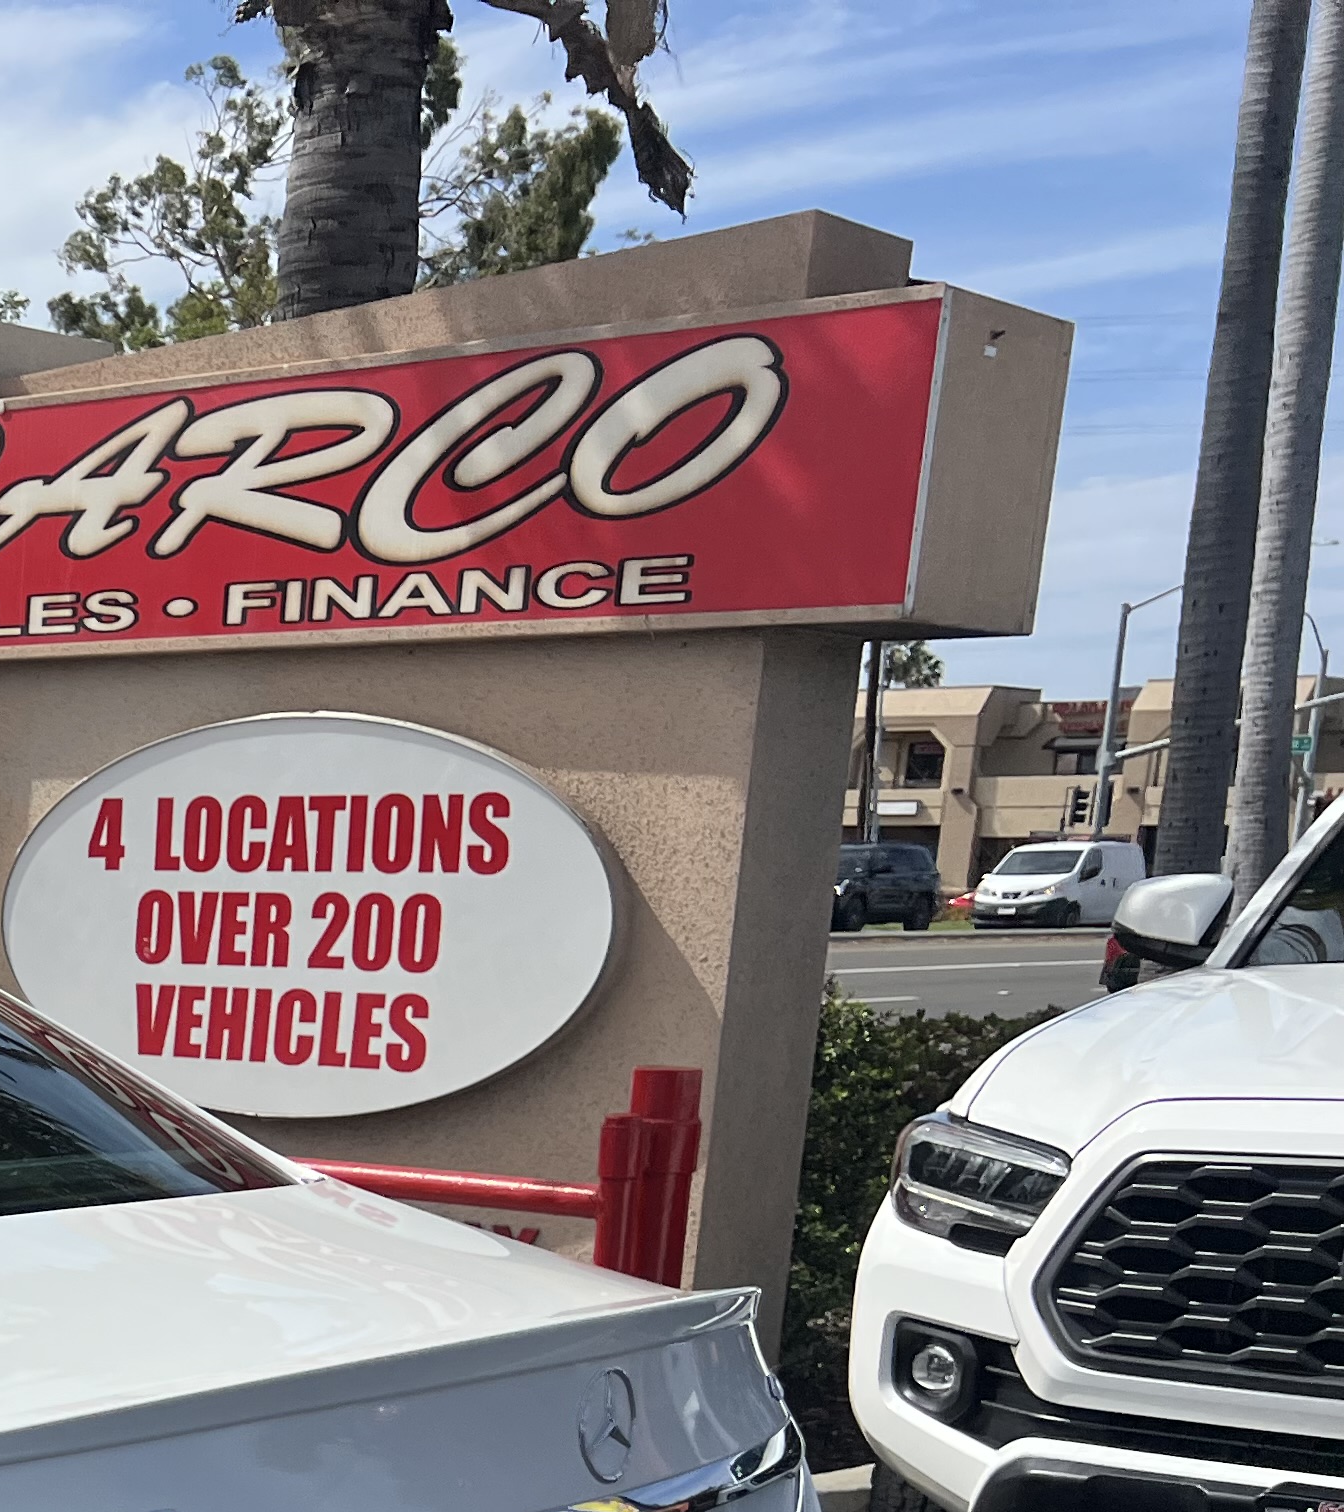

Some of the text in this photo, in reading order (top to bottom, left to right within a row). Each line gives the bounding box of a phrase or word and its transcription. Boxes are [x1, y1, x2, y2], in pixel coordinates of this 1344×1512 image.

[224, 554, 693, 626] FINANCE
[88, 792, 511, 875] 4 LOCATIONS
[135, 890, 442, 973] OVER 200
[135, 983, 430, 1073] VEHICLES
